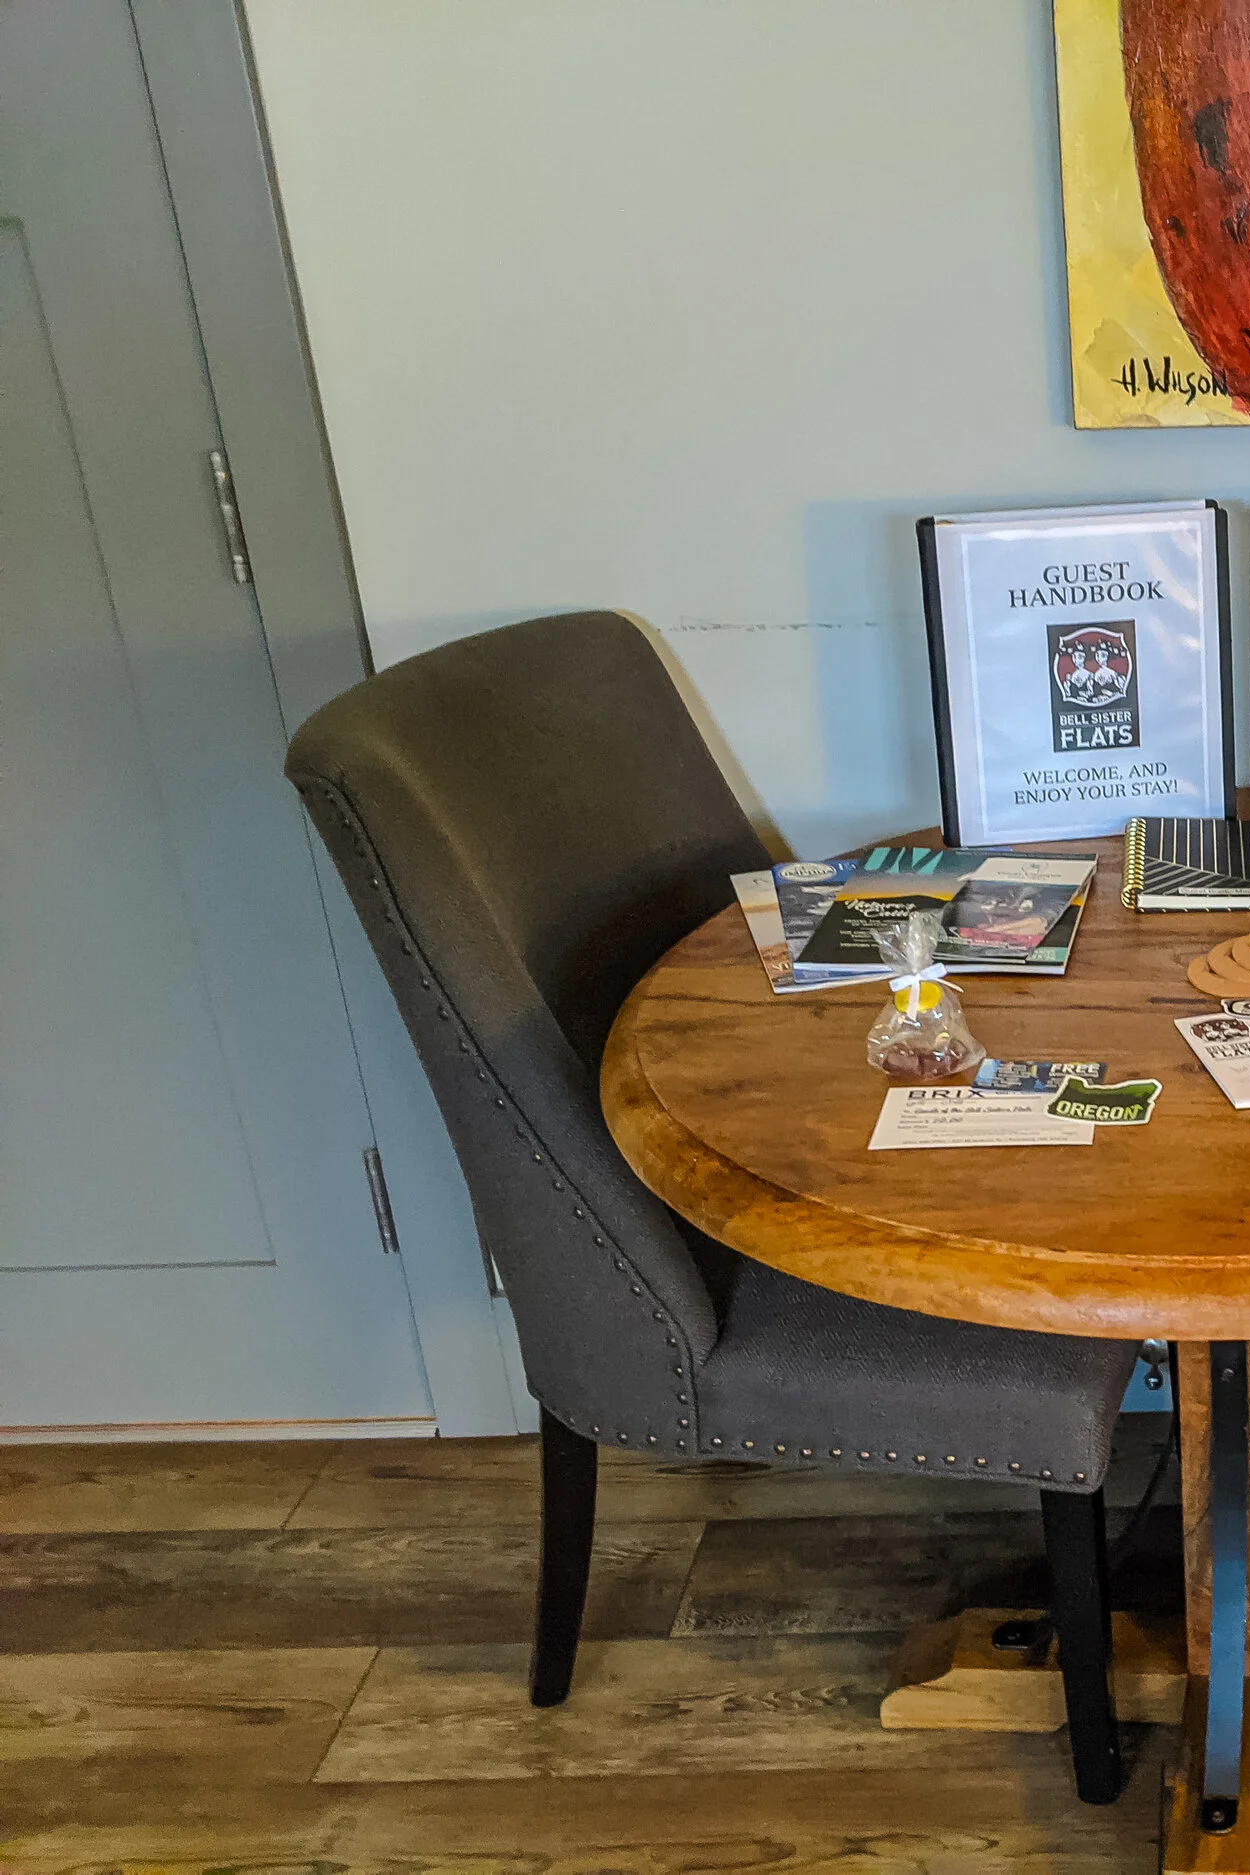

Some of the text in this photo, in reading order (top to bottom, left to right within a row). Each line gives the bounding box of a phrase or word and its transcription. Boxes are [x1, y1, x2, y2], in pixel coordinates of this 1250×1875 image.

[1043, 561, 1130, 585] GUEST
[1008, 580, 1164, 608] HANDBOOK
[1060, 711, 1132, 726] BELL SISTER
[1060, 725, 1133, 749] FLATS
[1023, 762, 1168, 786] WELCOME, AND
[1013, 779, 1179, 805] ENJOY YOUR STAY!
[1050, 1063, 1100, 1075] FREE
[908, 1089, 985, 1099] BRIX
[1056, 1100, 1143, 1120] OREGON
